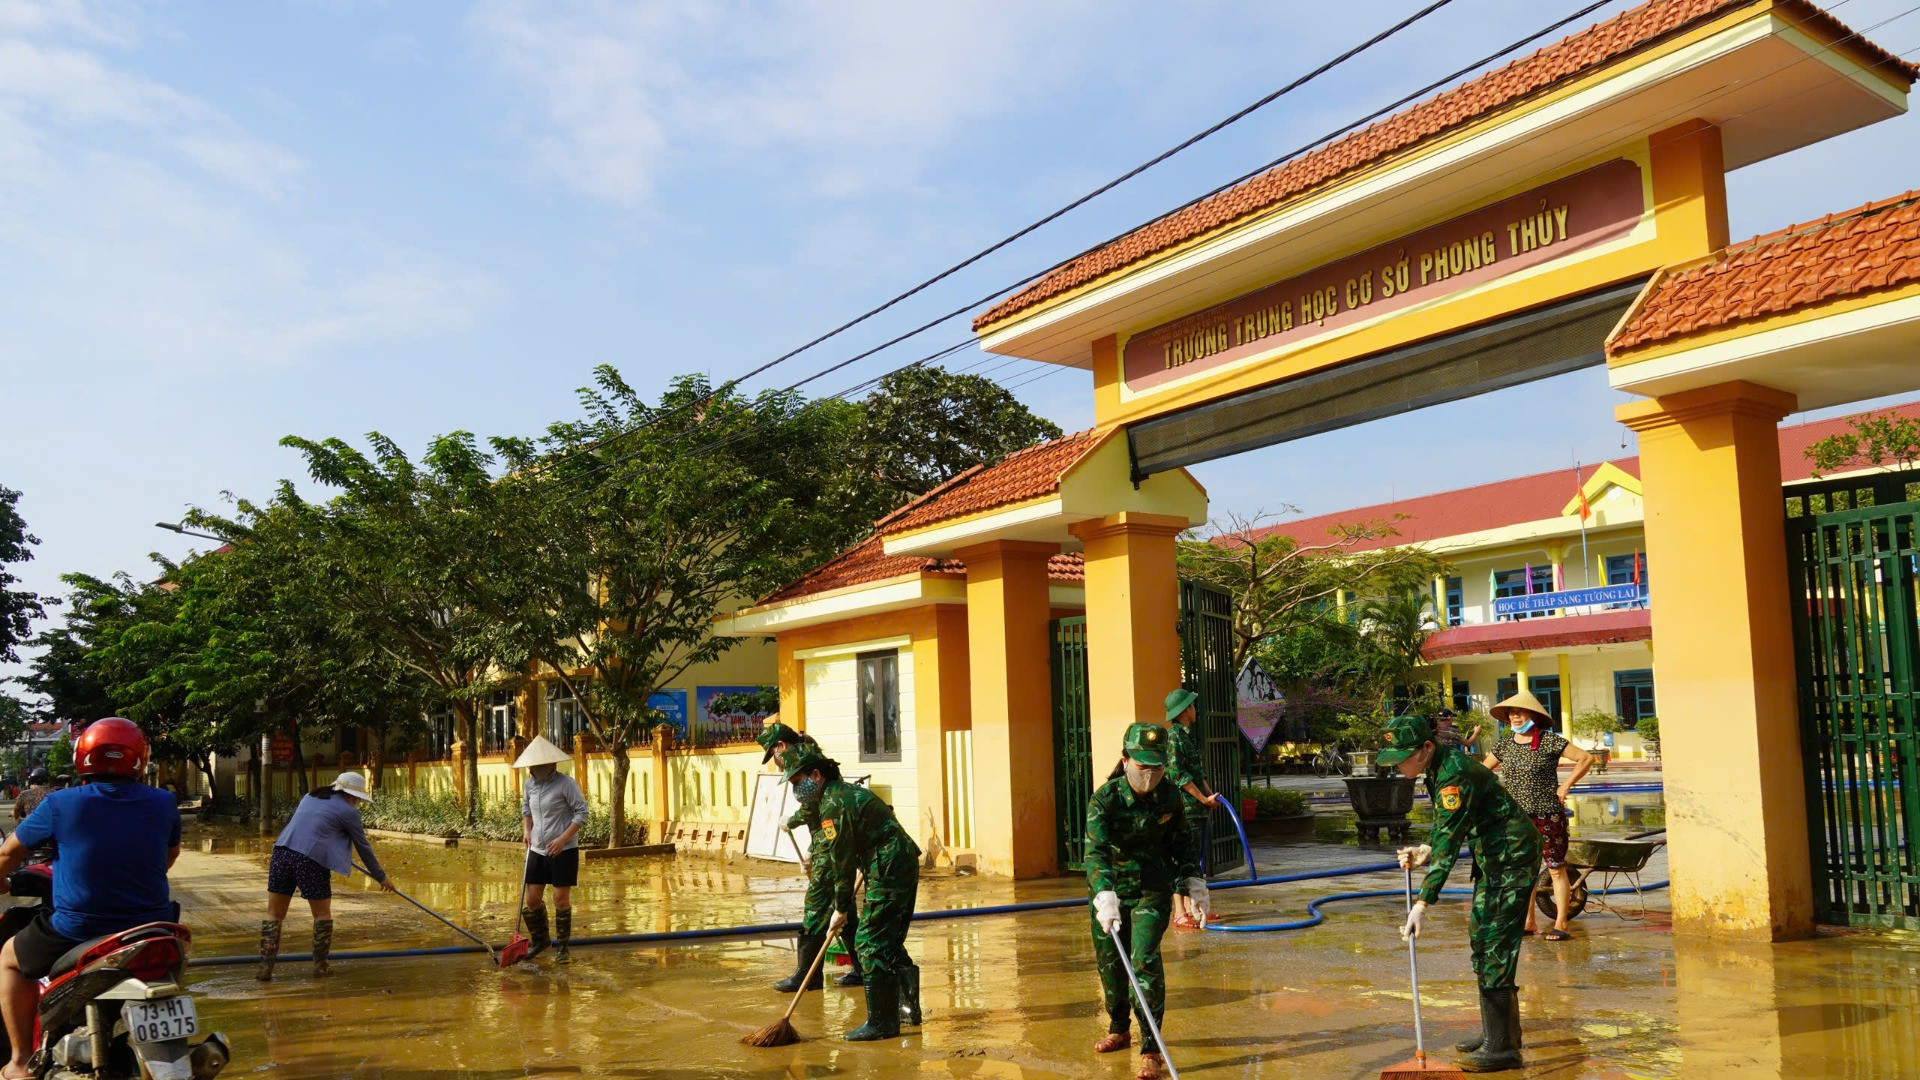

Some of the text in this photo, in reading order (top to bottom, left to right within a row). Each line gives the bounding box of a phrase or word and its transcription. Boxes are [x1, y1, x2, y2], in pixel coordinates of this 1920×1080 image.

[1234, 301, 1293, 346] TRUNG
[1301, 285, 1338, 326] HỌC
[1346, 269, 1373, 309] CƠ
[1382, 248, 1409, 297] SỞ
[1420, 231, 1496, 285] PHONG
[1507, 198, 1568, 256] THỦY
[1498, 601, 1516, 612] HỌC
[1557, 593, 1581, 605] SÁNG
[1583, 590, 1616, 602] TƯƠNG
[1618, 588, 1635, 599] LAI
[139, 999, 184, 1021] 73-H1
[137, 1016, 195, 1041] 083.75
